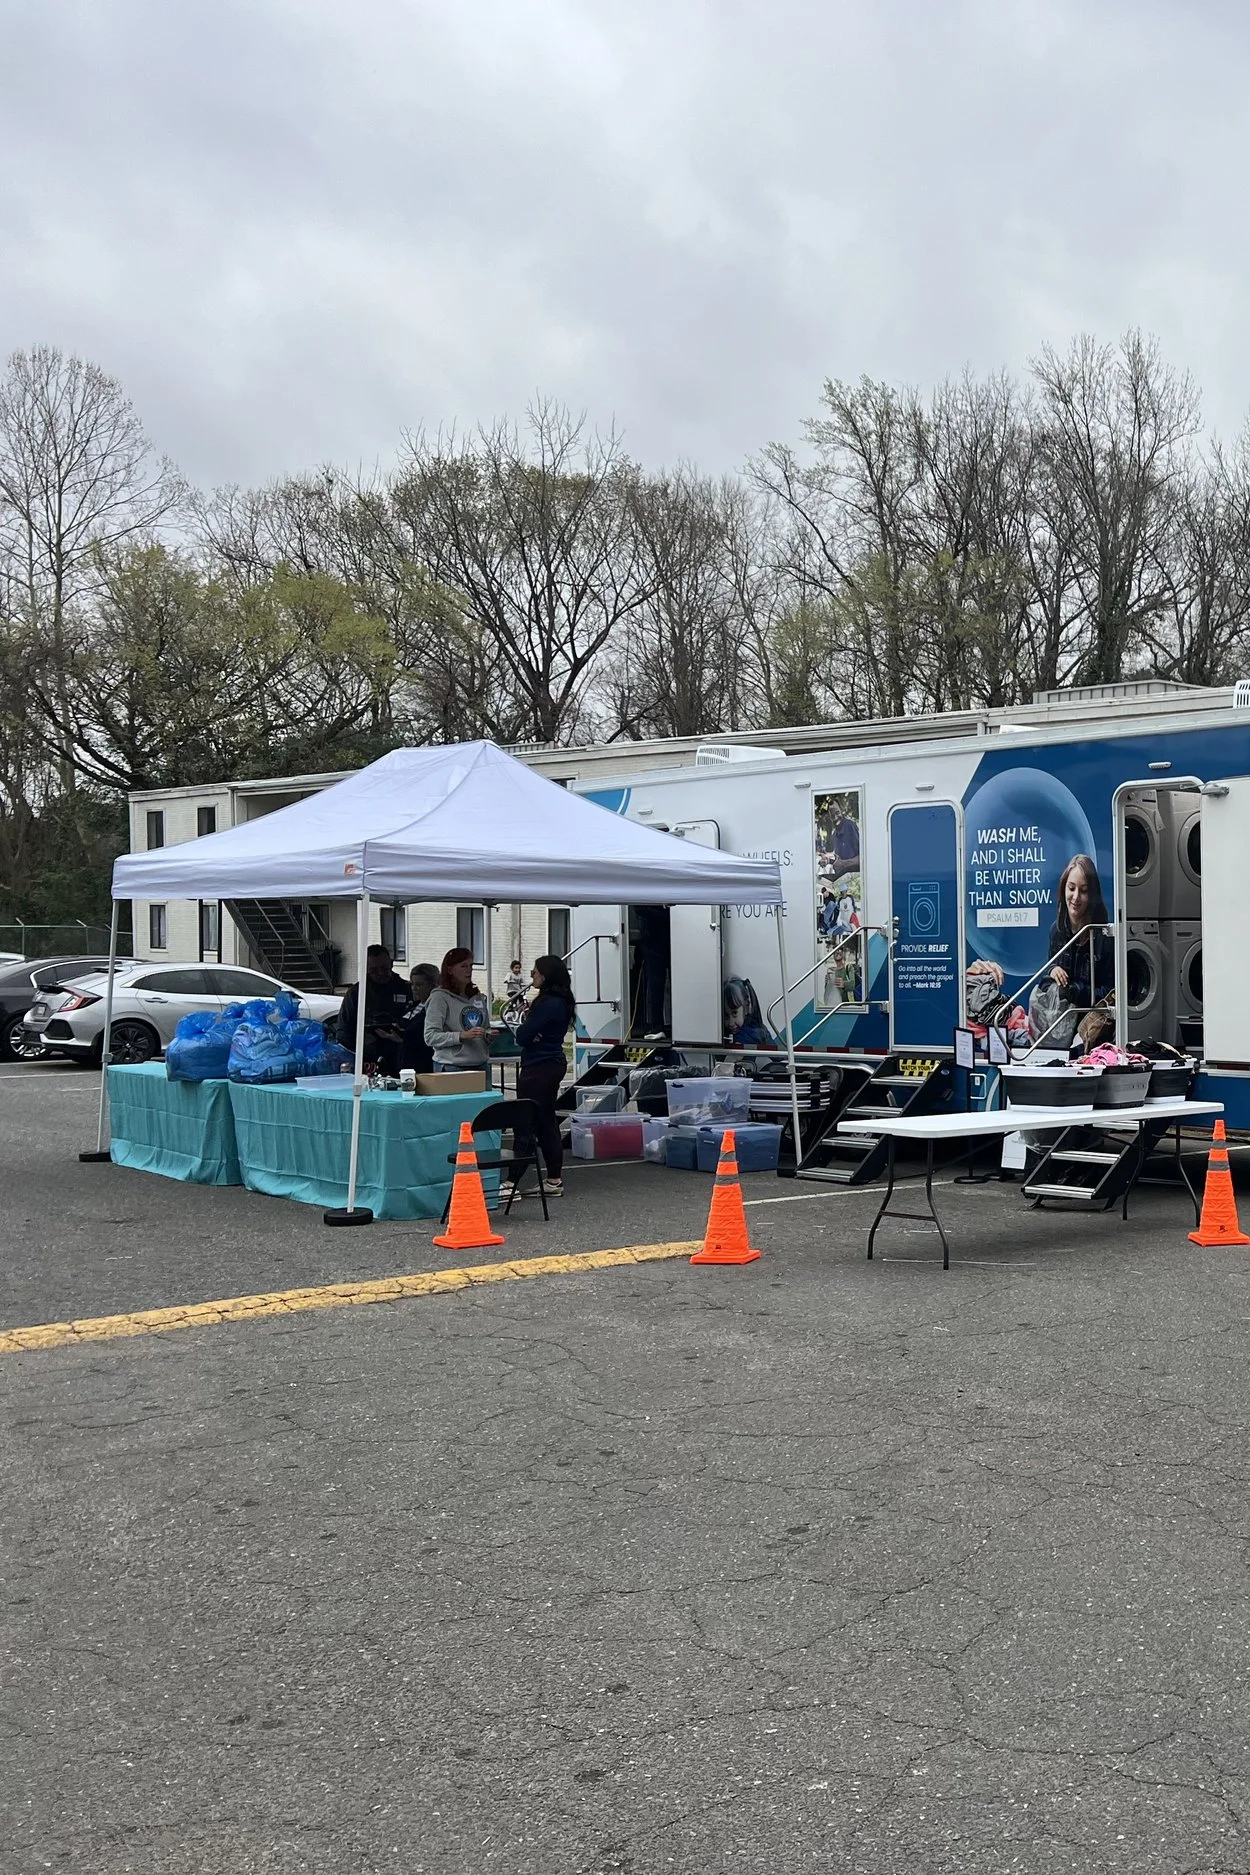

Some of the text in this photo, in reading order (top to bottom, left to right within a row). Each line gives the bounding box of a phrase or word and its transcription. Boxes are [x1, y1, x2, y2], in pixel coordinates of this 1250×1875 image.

[977, 826, 1042, 844] WASH ME,
[970, 847, 1047, 865] AND I SHALL
[975, 868, 1041, 885] BE WHITER
[968, 889, 1053, 906] THAN SNOW.
[736, 904, 761, 918] YOU
[986, 913, 1012, 923] PSALM
[900, 944, 949, 953] PROVIDE RELIEF
[909, 973, 927, 981] preach
[936, 973, 954, 982] gospel
